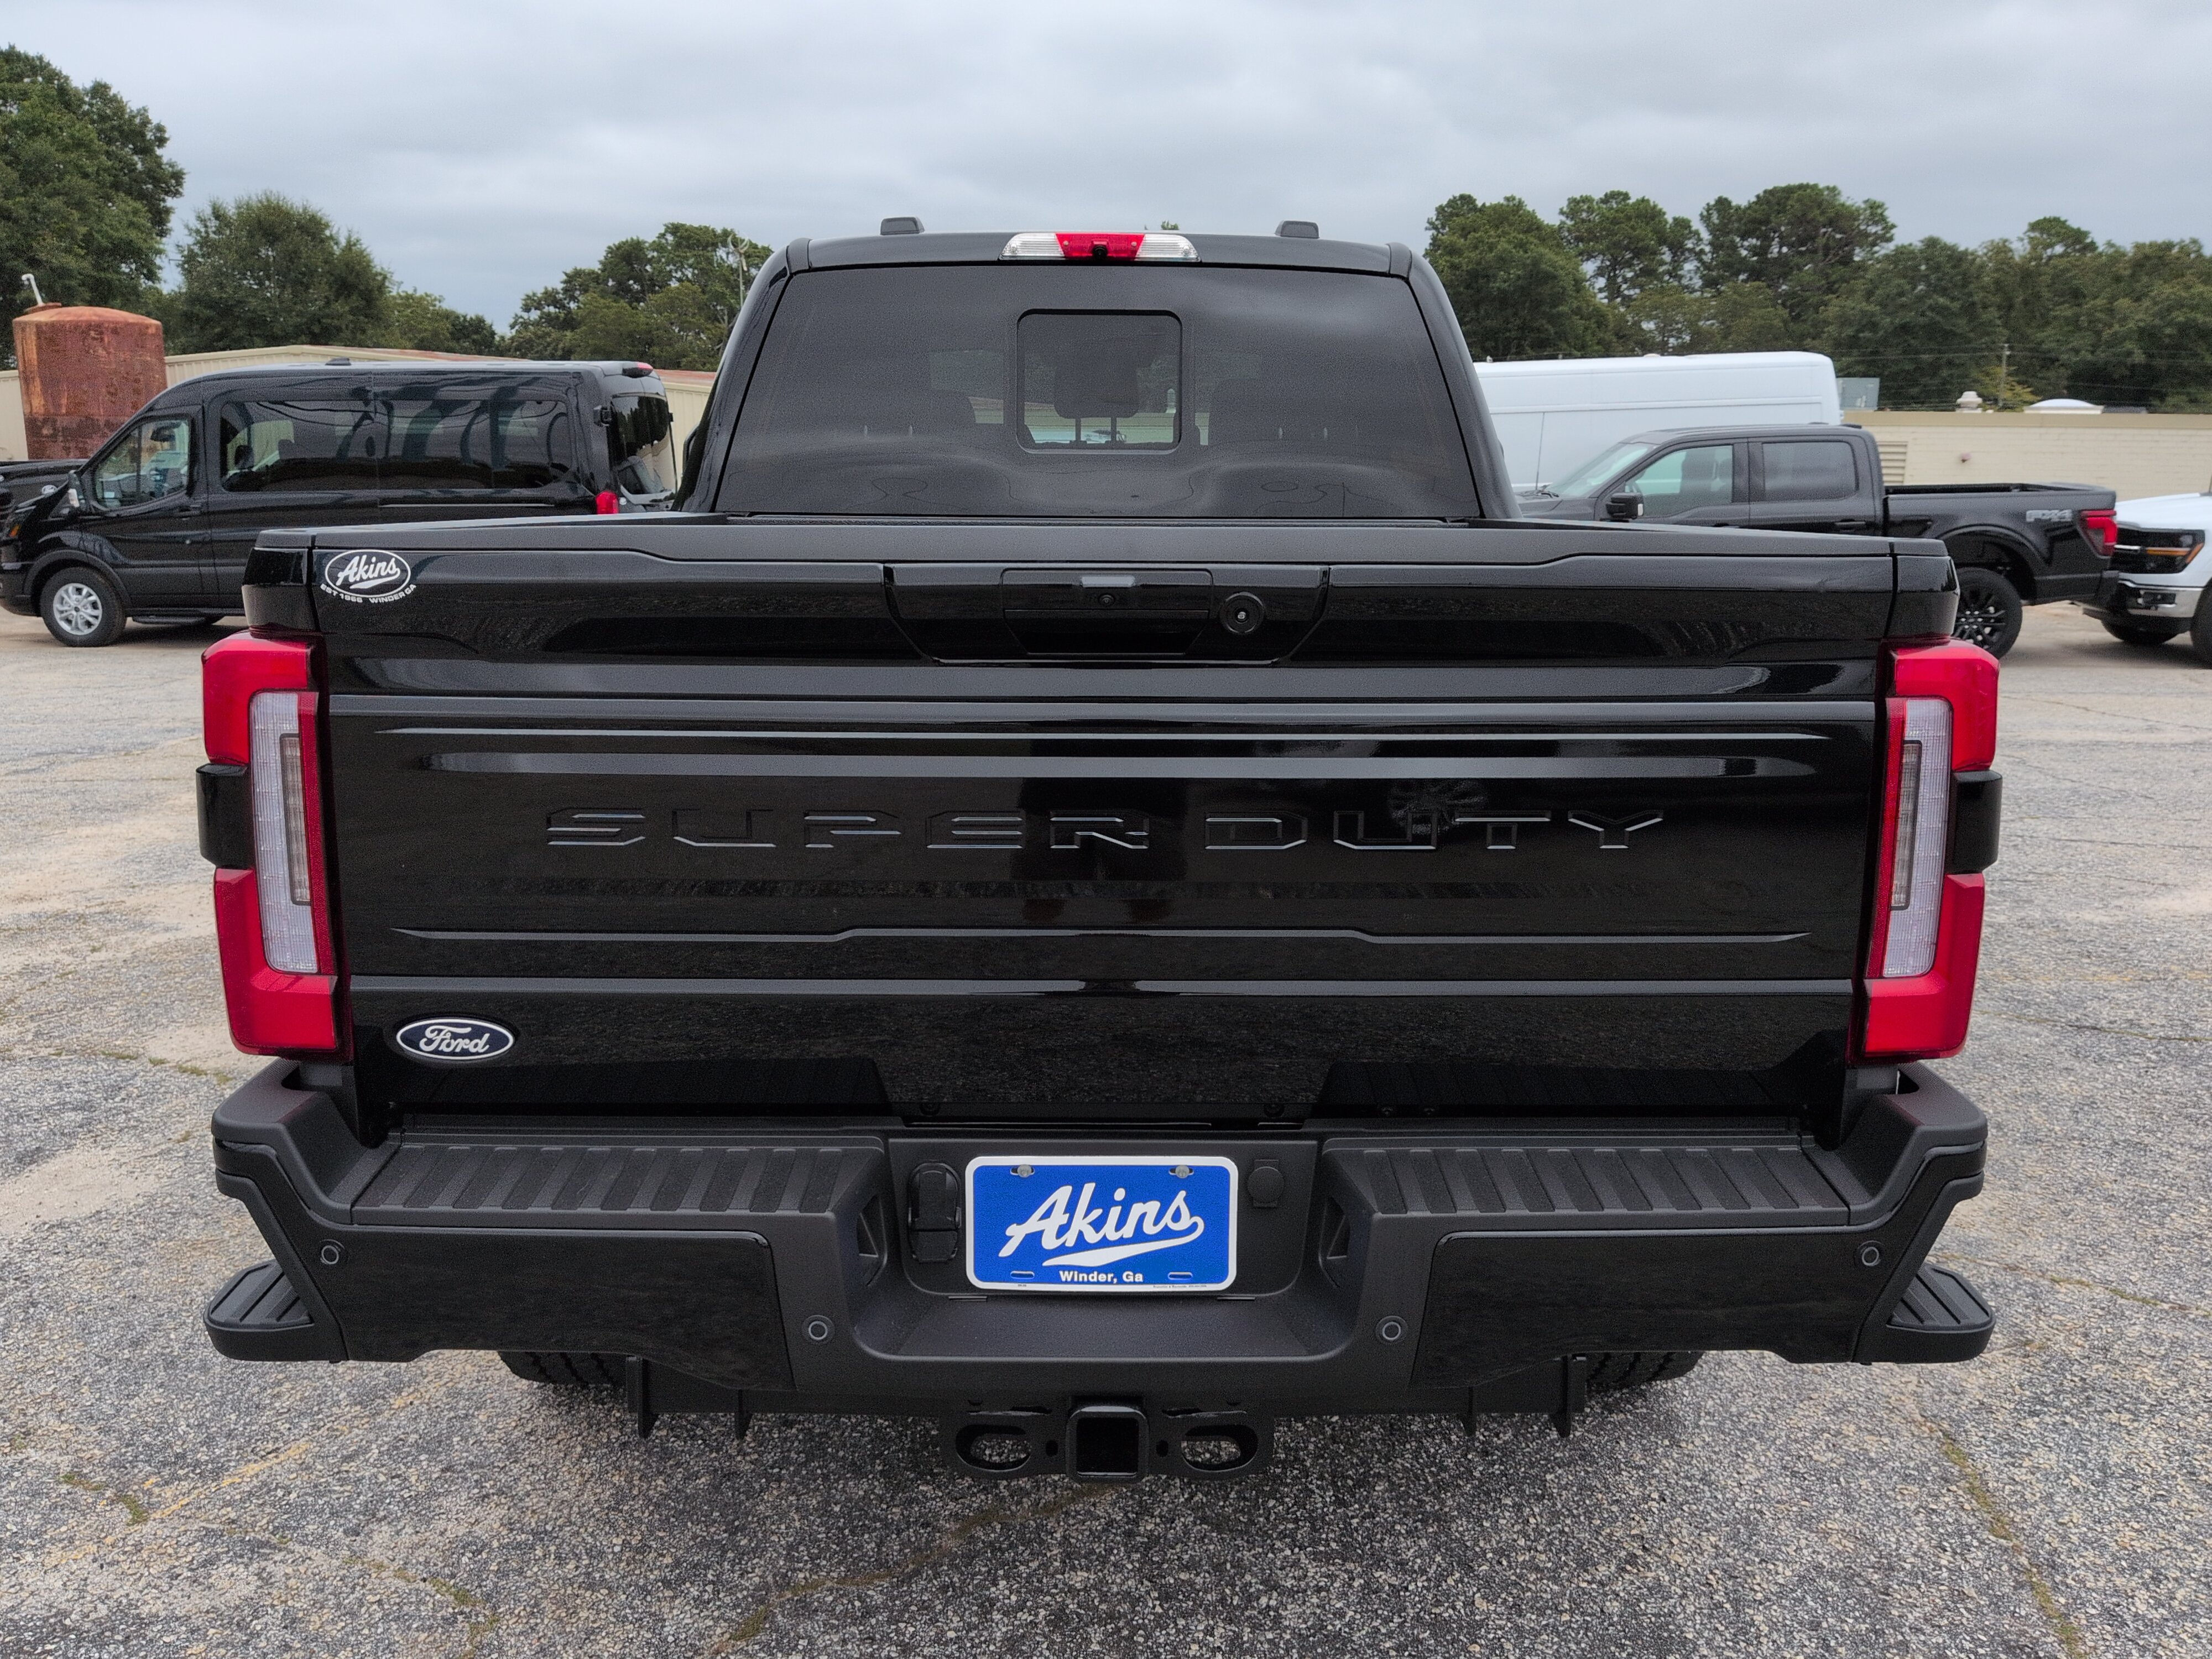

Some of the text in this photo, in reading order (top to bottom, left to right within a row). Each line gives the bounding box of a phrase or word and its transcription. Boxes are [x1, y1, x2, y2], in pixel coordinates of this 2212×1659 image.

[336, 555, 401, 586] Akins
[320, 583, 338, 596] EST
[368, 591, 406, 603] WINDER
[404, 584, 416, 594] GA
[546, 807, 1663, 851] SUPER DUTY
[419, 1025, 491, 1053] Ford
[998, 1182, 1204, 1257] Akins
[1058, 1270, 1144, 1284] Winder, Ga
